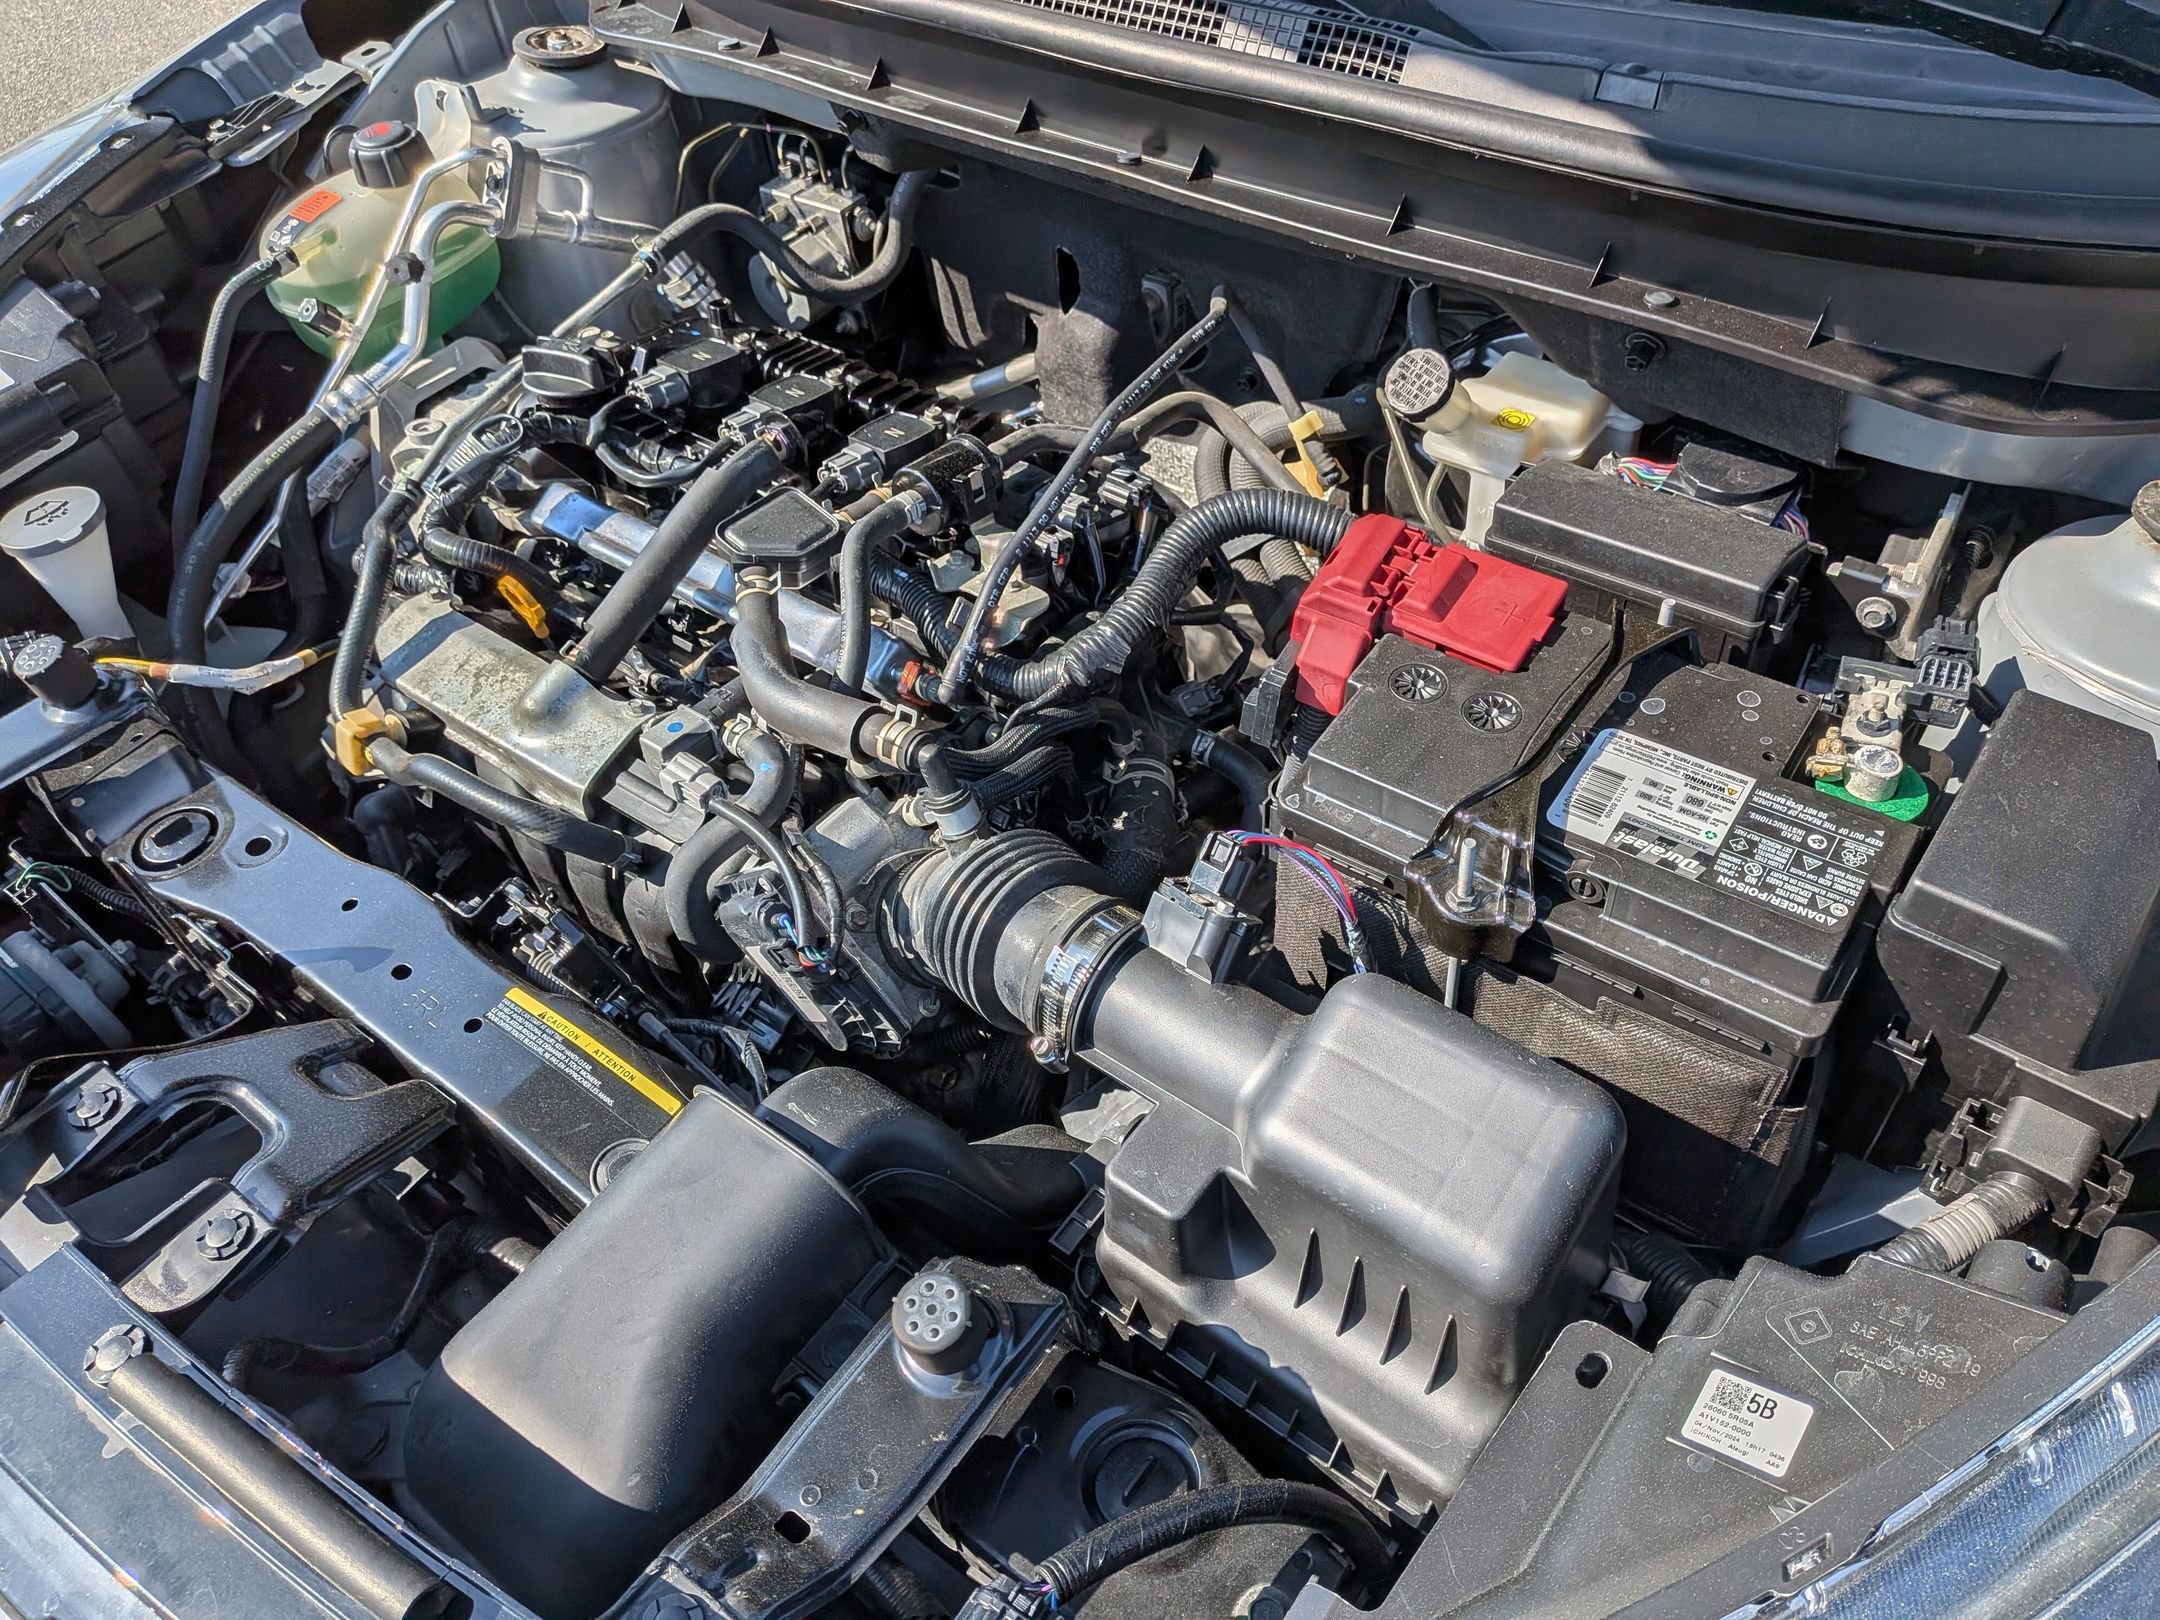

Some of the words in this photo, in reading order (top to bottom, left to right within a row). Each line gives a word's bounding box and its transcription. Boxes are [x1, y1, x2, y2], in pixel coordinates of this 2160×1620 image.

[1047, 495, 1059, 513] NOT
[1690, 761, 1705, 769] BEST
[1681, 772, 1725, 792] WARNING:
[1713, 769, 1748, 785] DISTRIBUTED
[1683, 782, 1736, 805] NON-SPILLABLE
[1754, 788, 1786, 803] BATTERY!
[1685, 795, 1704, 807] 680
[1752, 794, 1787, 812] CHILDREN.
[1785, 799, 1803, 810] OPEN
[1678, 807, 1708, 821] H5-AGM
[1802, 806, 1817, 815] NOT
[1749, 811, 1805, 836] INSTRUCTIONS.
[1797, 812, 1822, 825] REACH
[1624, 816, 1684, 841] TECHNOLOGY
[1822, 820, 1836, 831] THE
[1780, 830, 1802, 842] READ
[1848, 831, 1864, 840] OUT
[1761, 837, 1782, 849] MEDICAL
[1864, 837, 1884, 847] KEEP
[1613, 831, 1698, 873] Duralast
[1718, 852, 1741, 864] SMOKING
[1753, 848, 1787, 864] IMMEDIATELY
[1775, 849, 1789, 858] WITH
[1713, 864, 1735, 876] SPARKS
[1716, 858, 1737, 870] FLAMES
[1766, 859, 1784, 869] FLUSH
[1789, 866, 1806, 877] CAUSE
[1826, 867, 1845, 877] BURNS
[1744, 874, 1757, 884] NO
[1765, 875, 1783, 887] GASES
[1817, 877, 1832, 886] ACID
[1833, 876, 1862, 890] BLINDNESS
[1845, 873, 1865, 884] SEVERE
[1774, 887, 1790, 897] EYES
[1782, 882, 1811, 897] EXPLOSIVE
[1796, 880, 1826, 895] BLINDNESS
[1832, 882, 1859, 896] SULFURIC
[1717, 875, 1825, 922] DANGER/POISON
[1789, 893, 1808, 904] SHIELD
[1826, 891, 1843, 901] CAUSE
[546, 1015, 580, 1040] CAUTION
[592, 1048, 636, 1081] ATTENTION
[563, 1067, 591, 1088] APPROCHER
[1746, 1392, 1777, 1419] 5B
[1702, 1402, 1727, 1416] 26060
[1727, 1412, 1753, 1428] 5R05A
[1690, 1427, 1721, 1444] ICHIKOH
[1694, 1420, 1740, 1442] 04/Nov/2024
